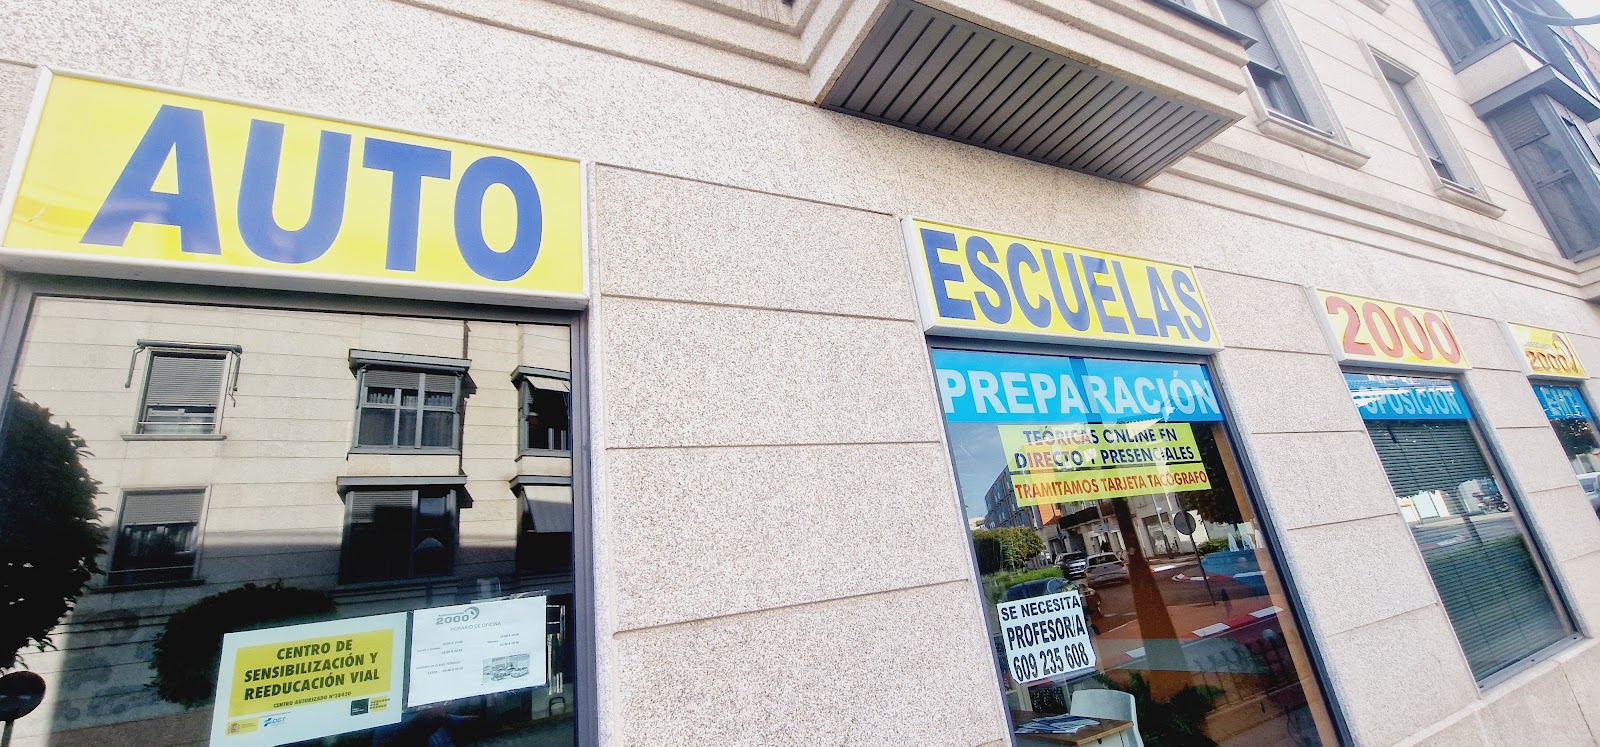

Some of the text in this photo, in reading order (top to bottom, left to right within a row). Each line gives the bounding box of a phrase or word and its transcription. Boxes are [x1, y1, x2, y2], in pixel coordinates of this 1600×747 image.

[79, 104, 543, 282] AUTO
[919, 227, 1212, 343] ESCUELAS
[1325, 295, 1462, 364] 2000
[1525, 350, 1572, 374] 2000
[936, 368, 1221, 415] PREPARACIÓN
[1022, 425, 1100, 446] TEÓRICAS
[1159, 428, 1178, 443] EN
[1014, 450, 1084, 469] DIRECTO
[1100, 445, 1196, 465] PRESENCIALES
[1014, 467, 1208, 500] TRAMITAMOS TARJETA TACÓGRAFO
[436, 614, 469, 625] 2000
[1001, 595, 1081, 622] SE NECESITA
[1006, 614, 1086, 651] PROFESOR/A
[276, 639, 353, 660] CENTRO DE
[1013, 641, 1090, 682] 609 235 608
[244, 652, 379, 683] SENSIBILIZACIÓN Y
[244, 669, 380, 700] REEDUCACIÓN VIAL
[273, 700, 294, 709] CENTRO
[294, 695, 328, 705] AUTORIZADO
